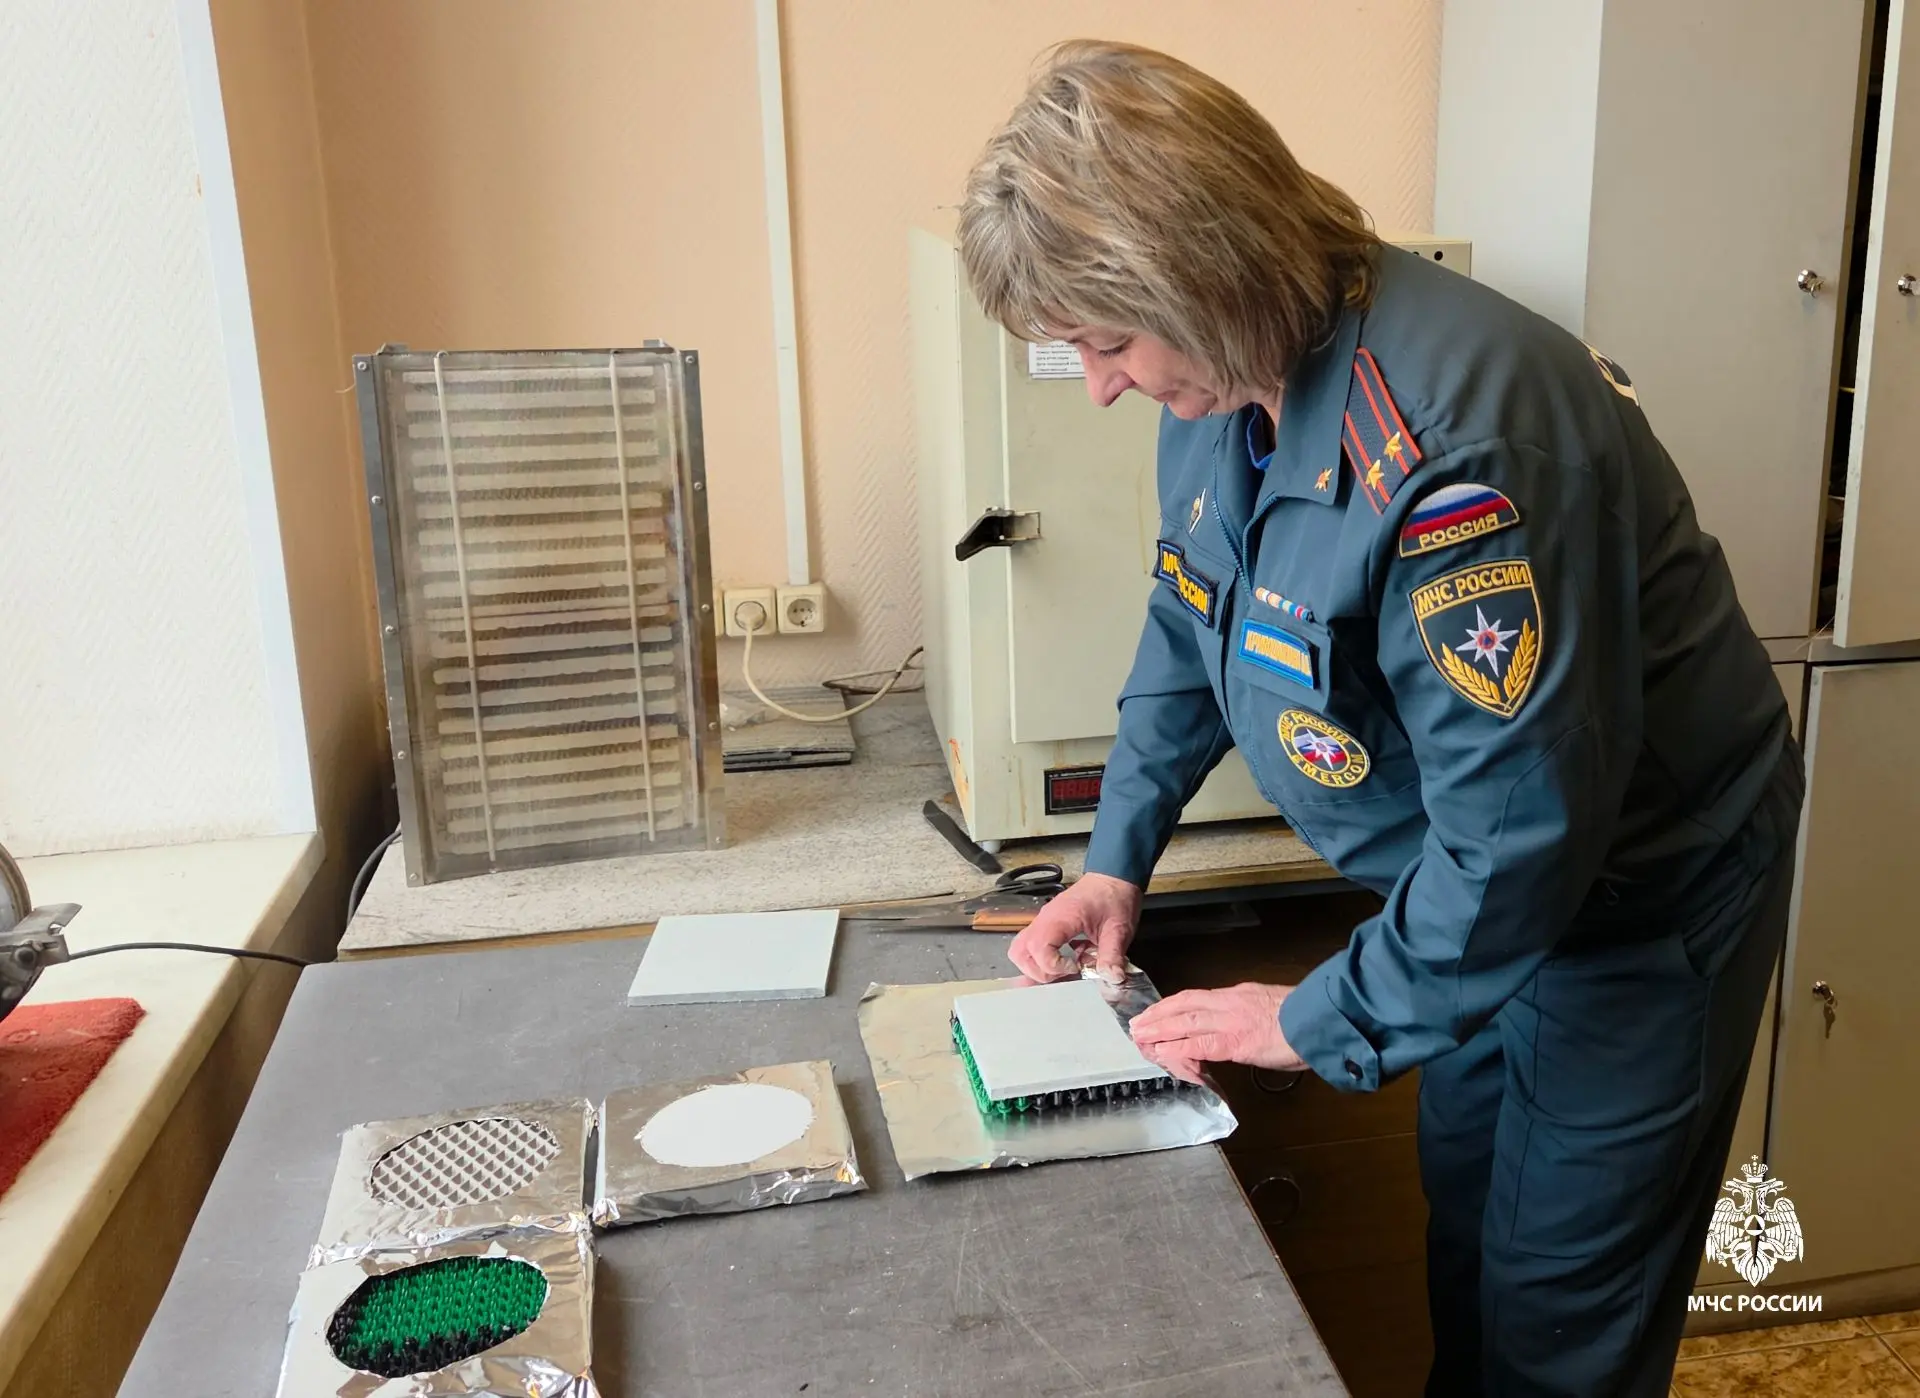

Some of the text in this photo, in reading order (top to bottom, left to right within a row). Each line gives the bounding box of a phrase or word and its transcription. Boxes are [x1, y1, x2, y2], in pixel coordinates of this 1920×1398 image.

[1419, 512, 1499, 549] РОССИЯ
[1417, 565, 1529, 615] МЧС РОССИИ
[1291, 753, 1364, 785] EMERCOM
